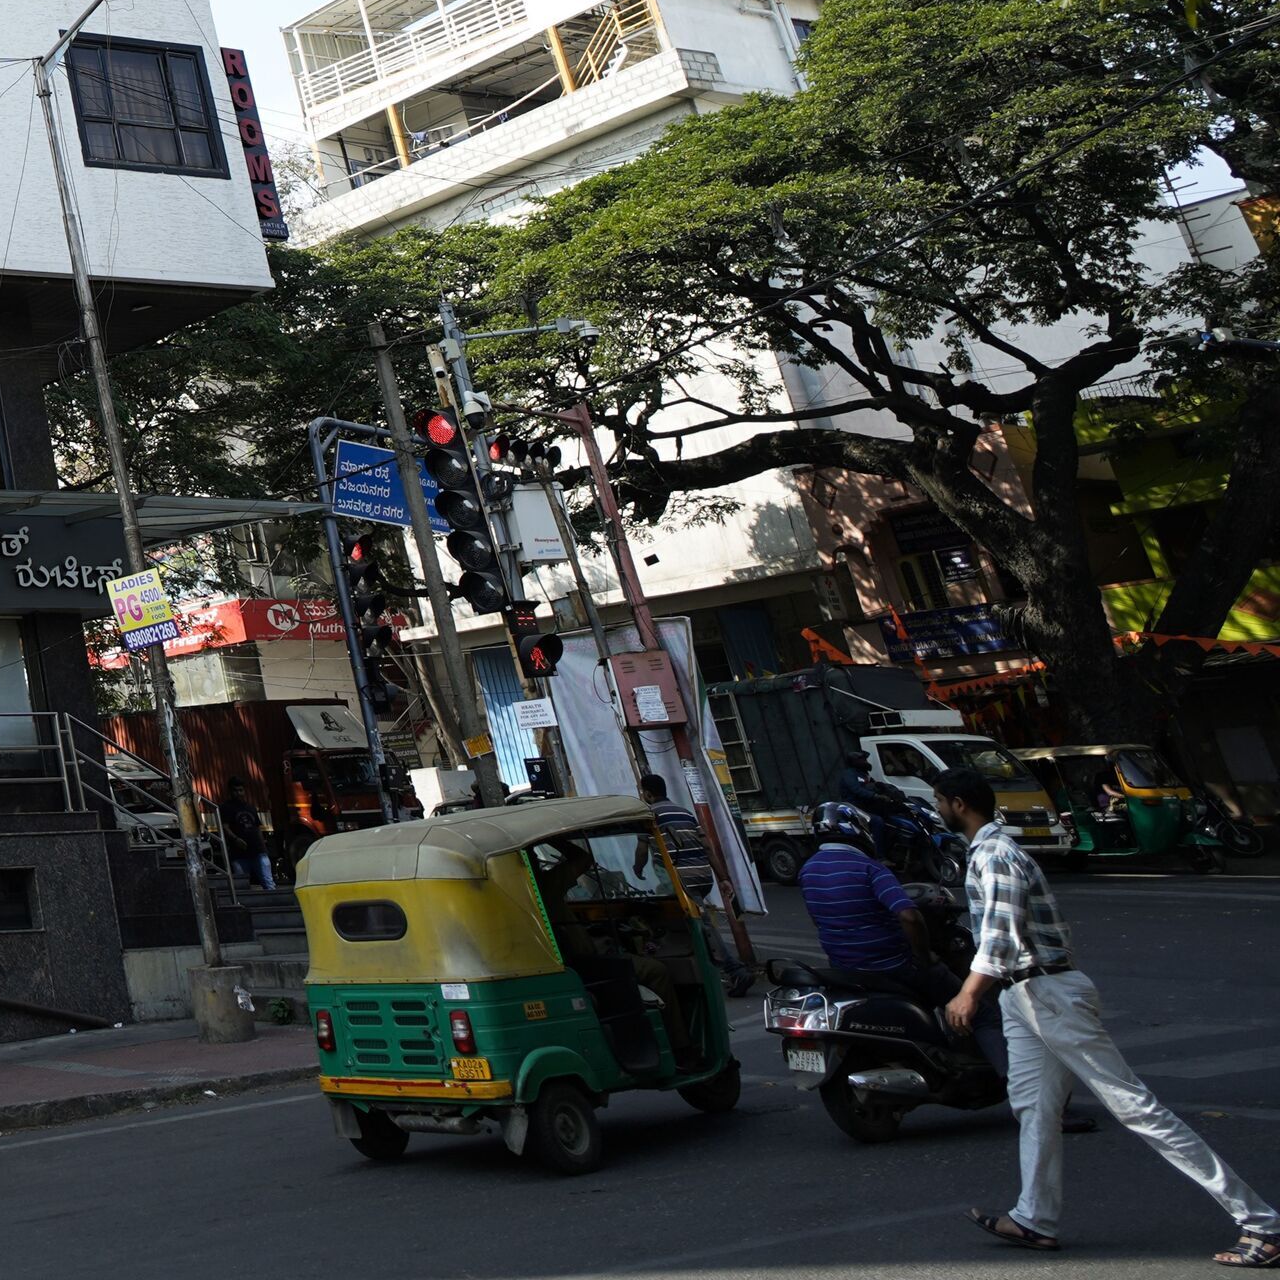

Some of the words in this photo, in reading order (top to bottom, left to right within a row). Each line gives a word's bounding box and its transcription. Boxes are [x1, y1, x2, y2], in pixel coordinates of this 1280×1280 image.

[222, 49, 280, 218] ROOMS
[339, 478, 391, 498] ವಿಜಯನಗರ
[382, 506, 404, 519] ನಗರ
[113, 573, 154, 592] LADIES
[114, 594, 144, 625] PG
[152, 612, 166, 620] FOOD
[125, 622, 177, 648] 9980821268
